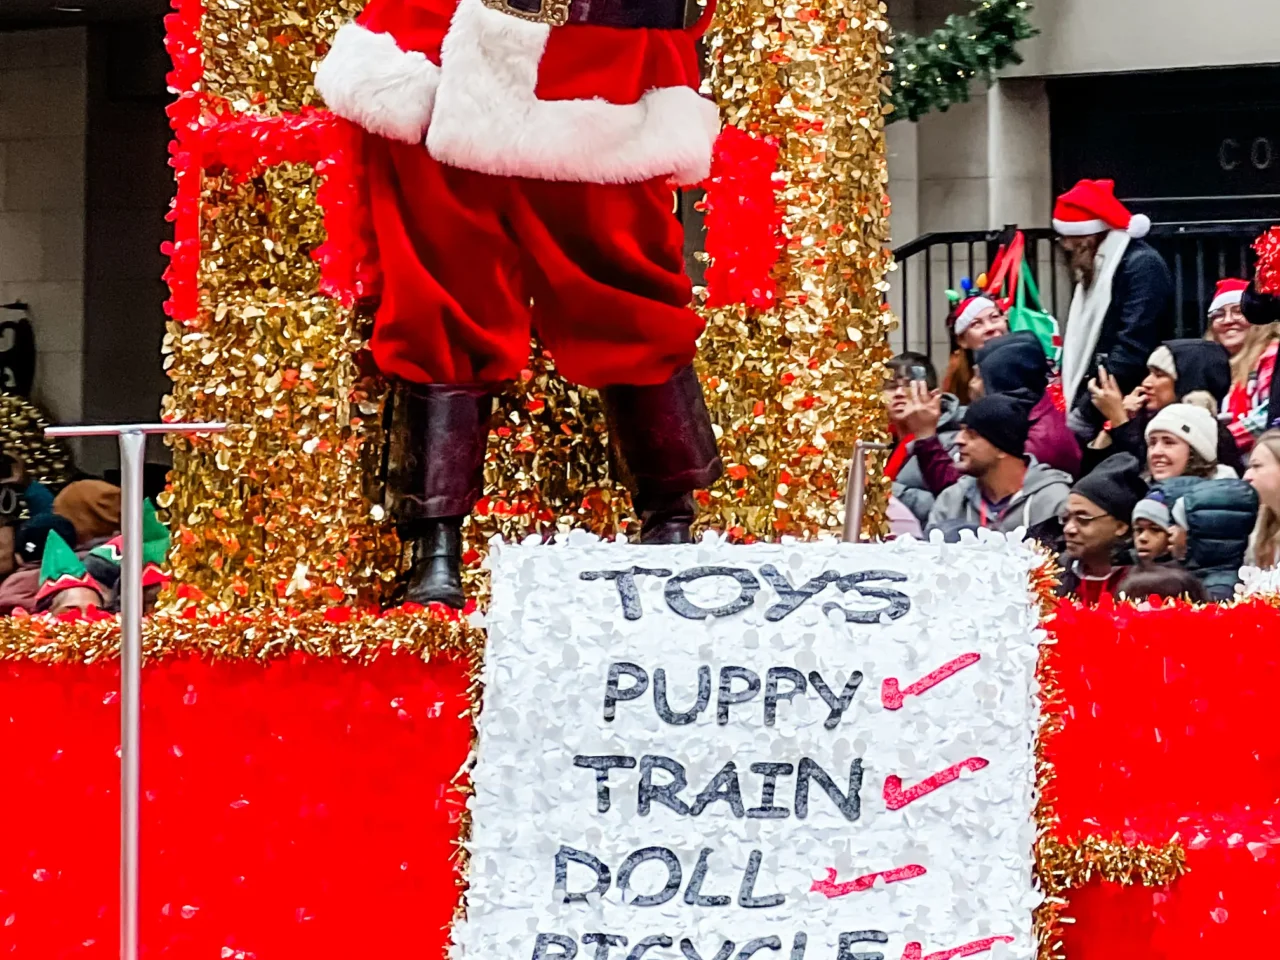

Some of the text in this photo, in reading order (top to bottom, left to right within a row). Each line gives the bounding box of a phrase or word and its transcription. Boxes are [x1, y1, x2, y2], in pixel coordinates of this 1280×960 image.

[580, 564, 912, 624] TOYS
[603, 661, 864, 730] PUPPY
[573, 754, 865, 821] TRAIN
[554, 845, 786, 909] DOLL
